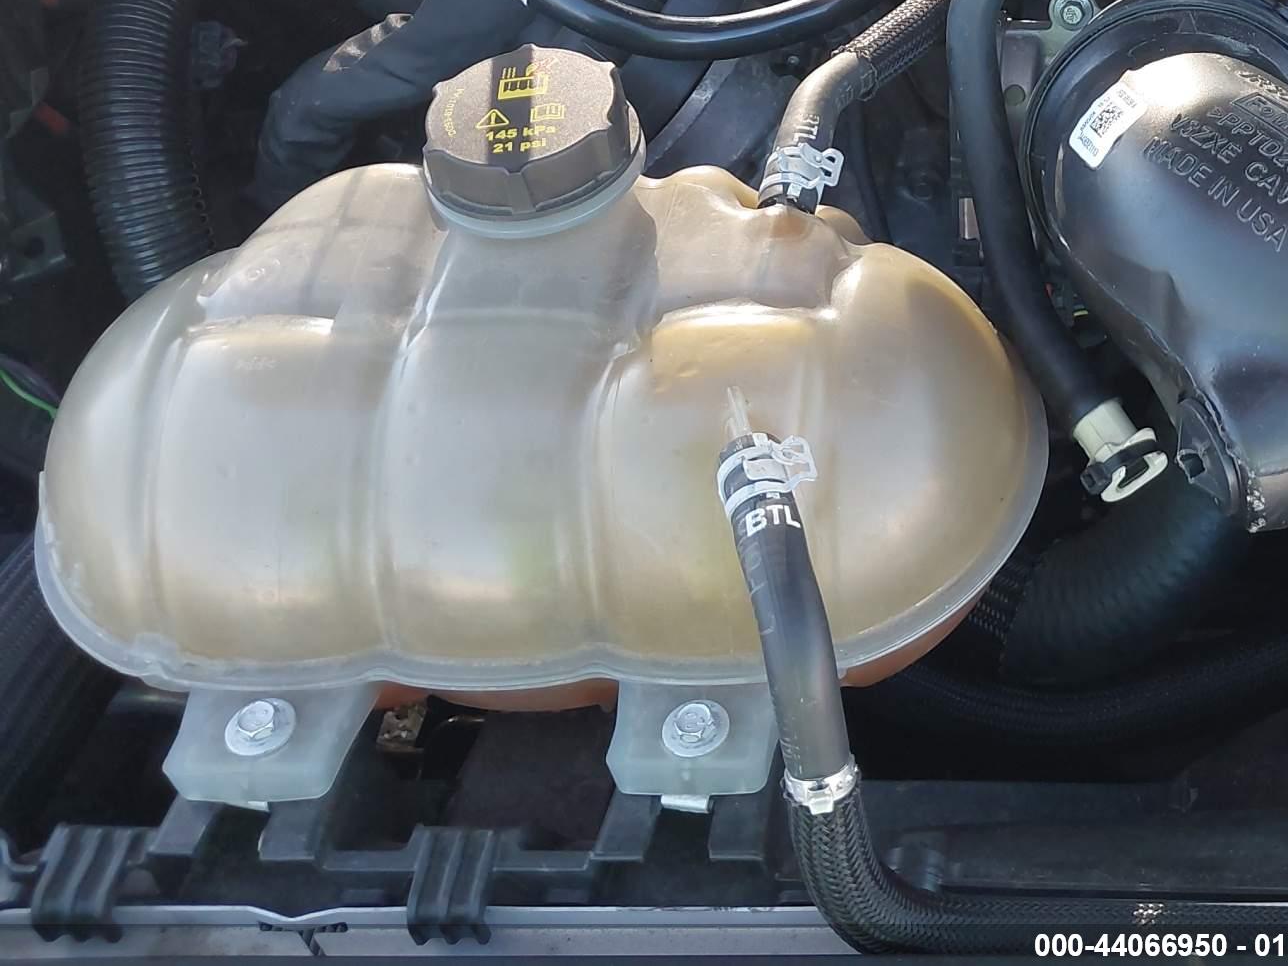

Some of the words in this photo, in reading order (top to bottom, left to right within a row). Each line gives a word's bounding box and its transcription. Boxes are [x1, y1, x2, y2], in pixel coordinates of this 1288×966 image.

[486, 128, 517, 141] 145
[523, 125, 556, 137] kPa
[493, 141, 512, 154] 21
[520, 137, 546, 153] psi
[1142, 136, 1210, 188] MADE
[1208, 175, 1239, 207] IN
[1236, 198, 1288, 253] USA
[745, 505, 802, 538] BTL
